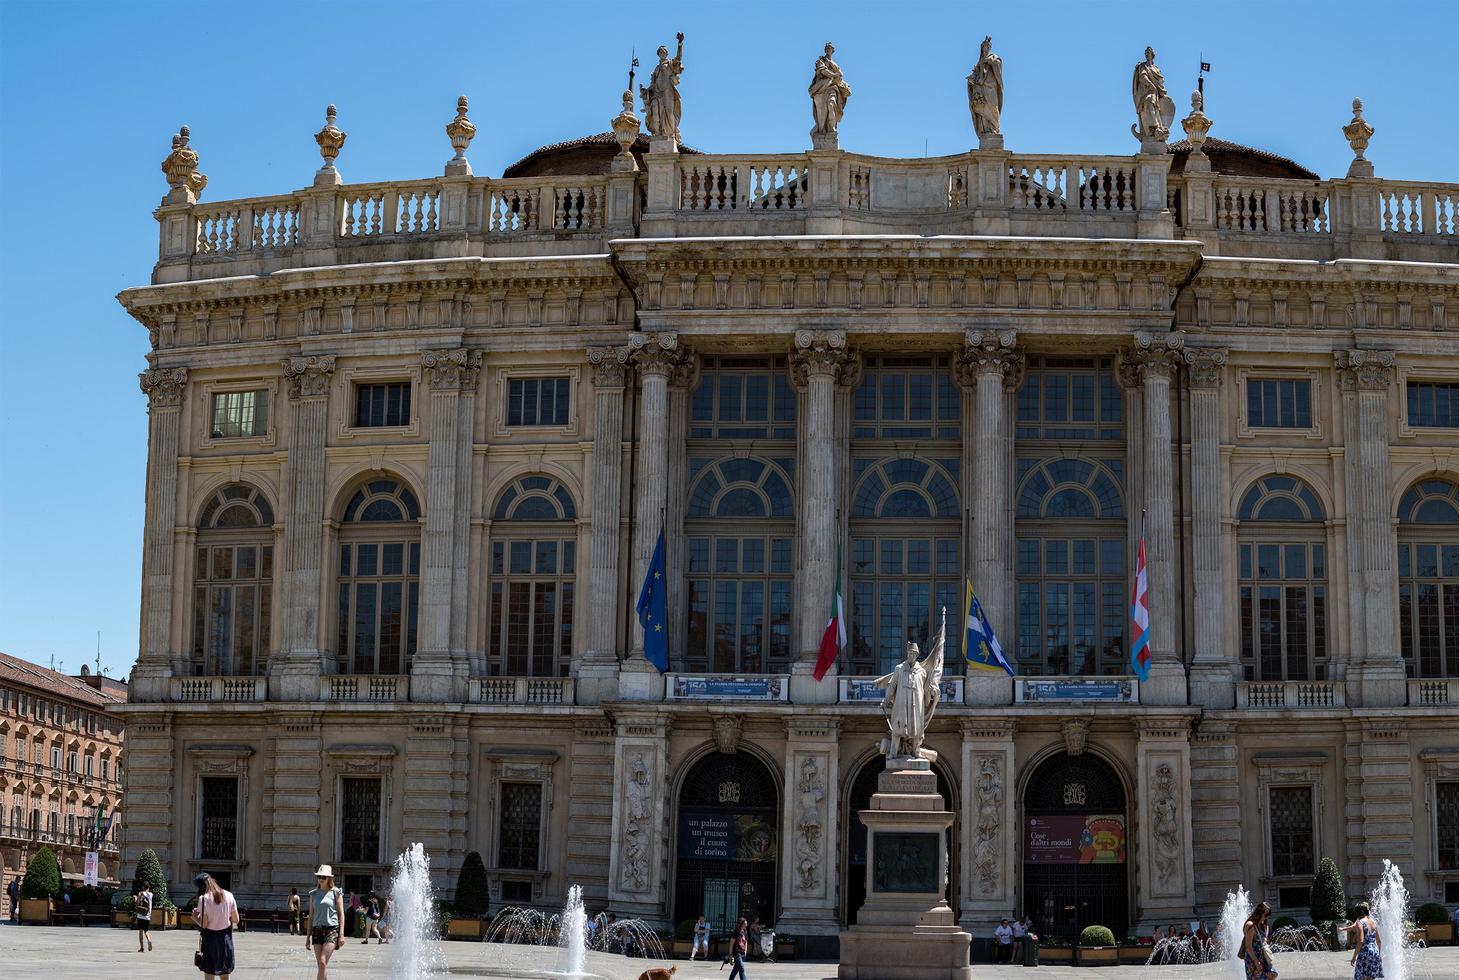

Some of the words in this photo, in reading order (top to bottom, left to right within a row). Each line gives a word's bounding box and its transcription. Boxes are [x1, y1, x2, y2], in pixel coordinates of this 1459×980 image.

[688, 681, 707, 689] 150
[1037, 684, 1057, 692] 150
[701, 818, 728, 829] palazzo
[700, 837, 705, 846] il
[695, 847, 703, 855] di
[705, 848, 727, 856] torino
